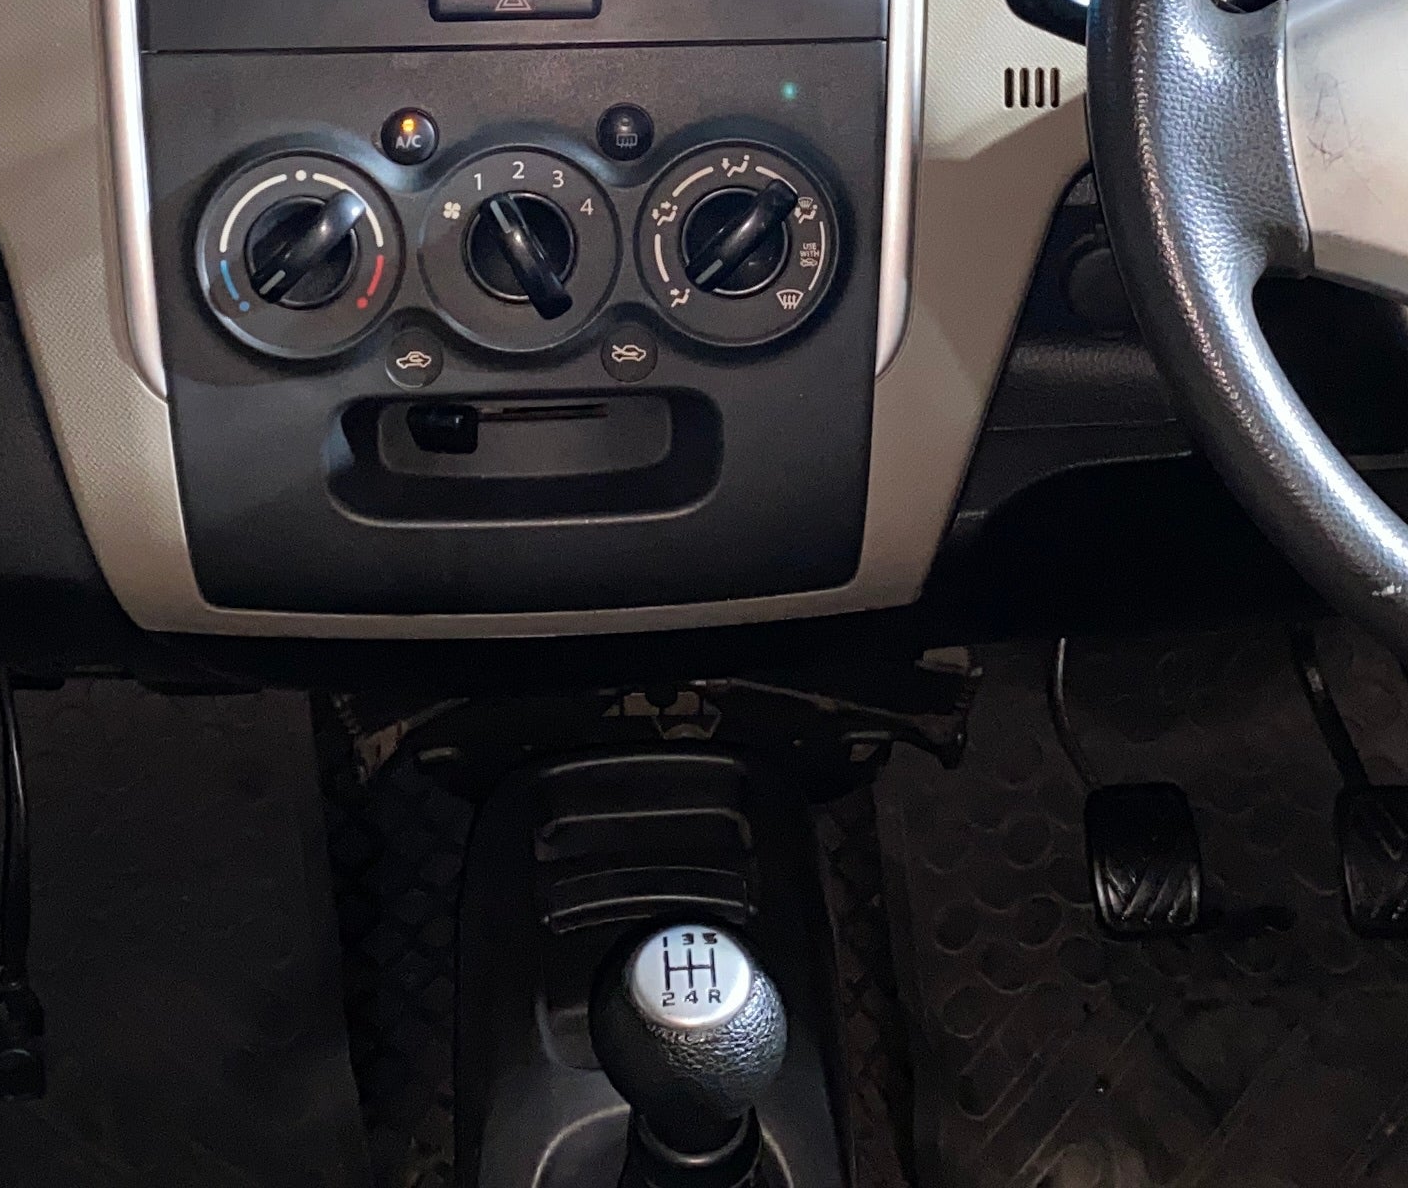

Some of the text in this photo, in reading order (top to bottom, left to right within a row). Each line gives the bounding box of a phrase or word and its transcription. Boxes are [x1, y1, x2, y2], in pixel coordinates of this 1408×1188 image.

[395, 135, 422, 149] A/C
[512, 161, 525, 179] 2
[552, 170, 565, 188] 3
[473, 173, 482, 191] 1
[580, 198, 594, 216] 4
[682, 933, 694, 945] 3
[702, 932, 718, 945] 5
[662, 990, 722, 1007] 2 4 R
